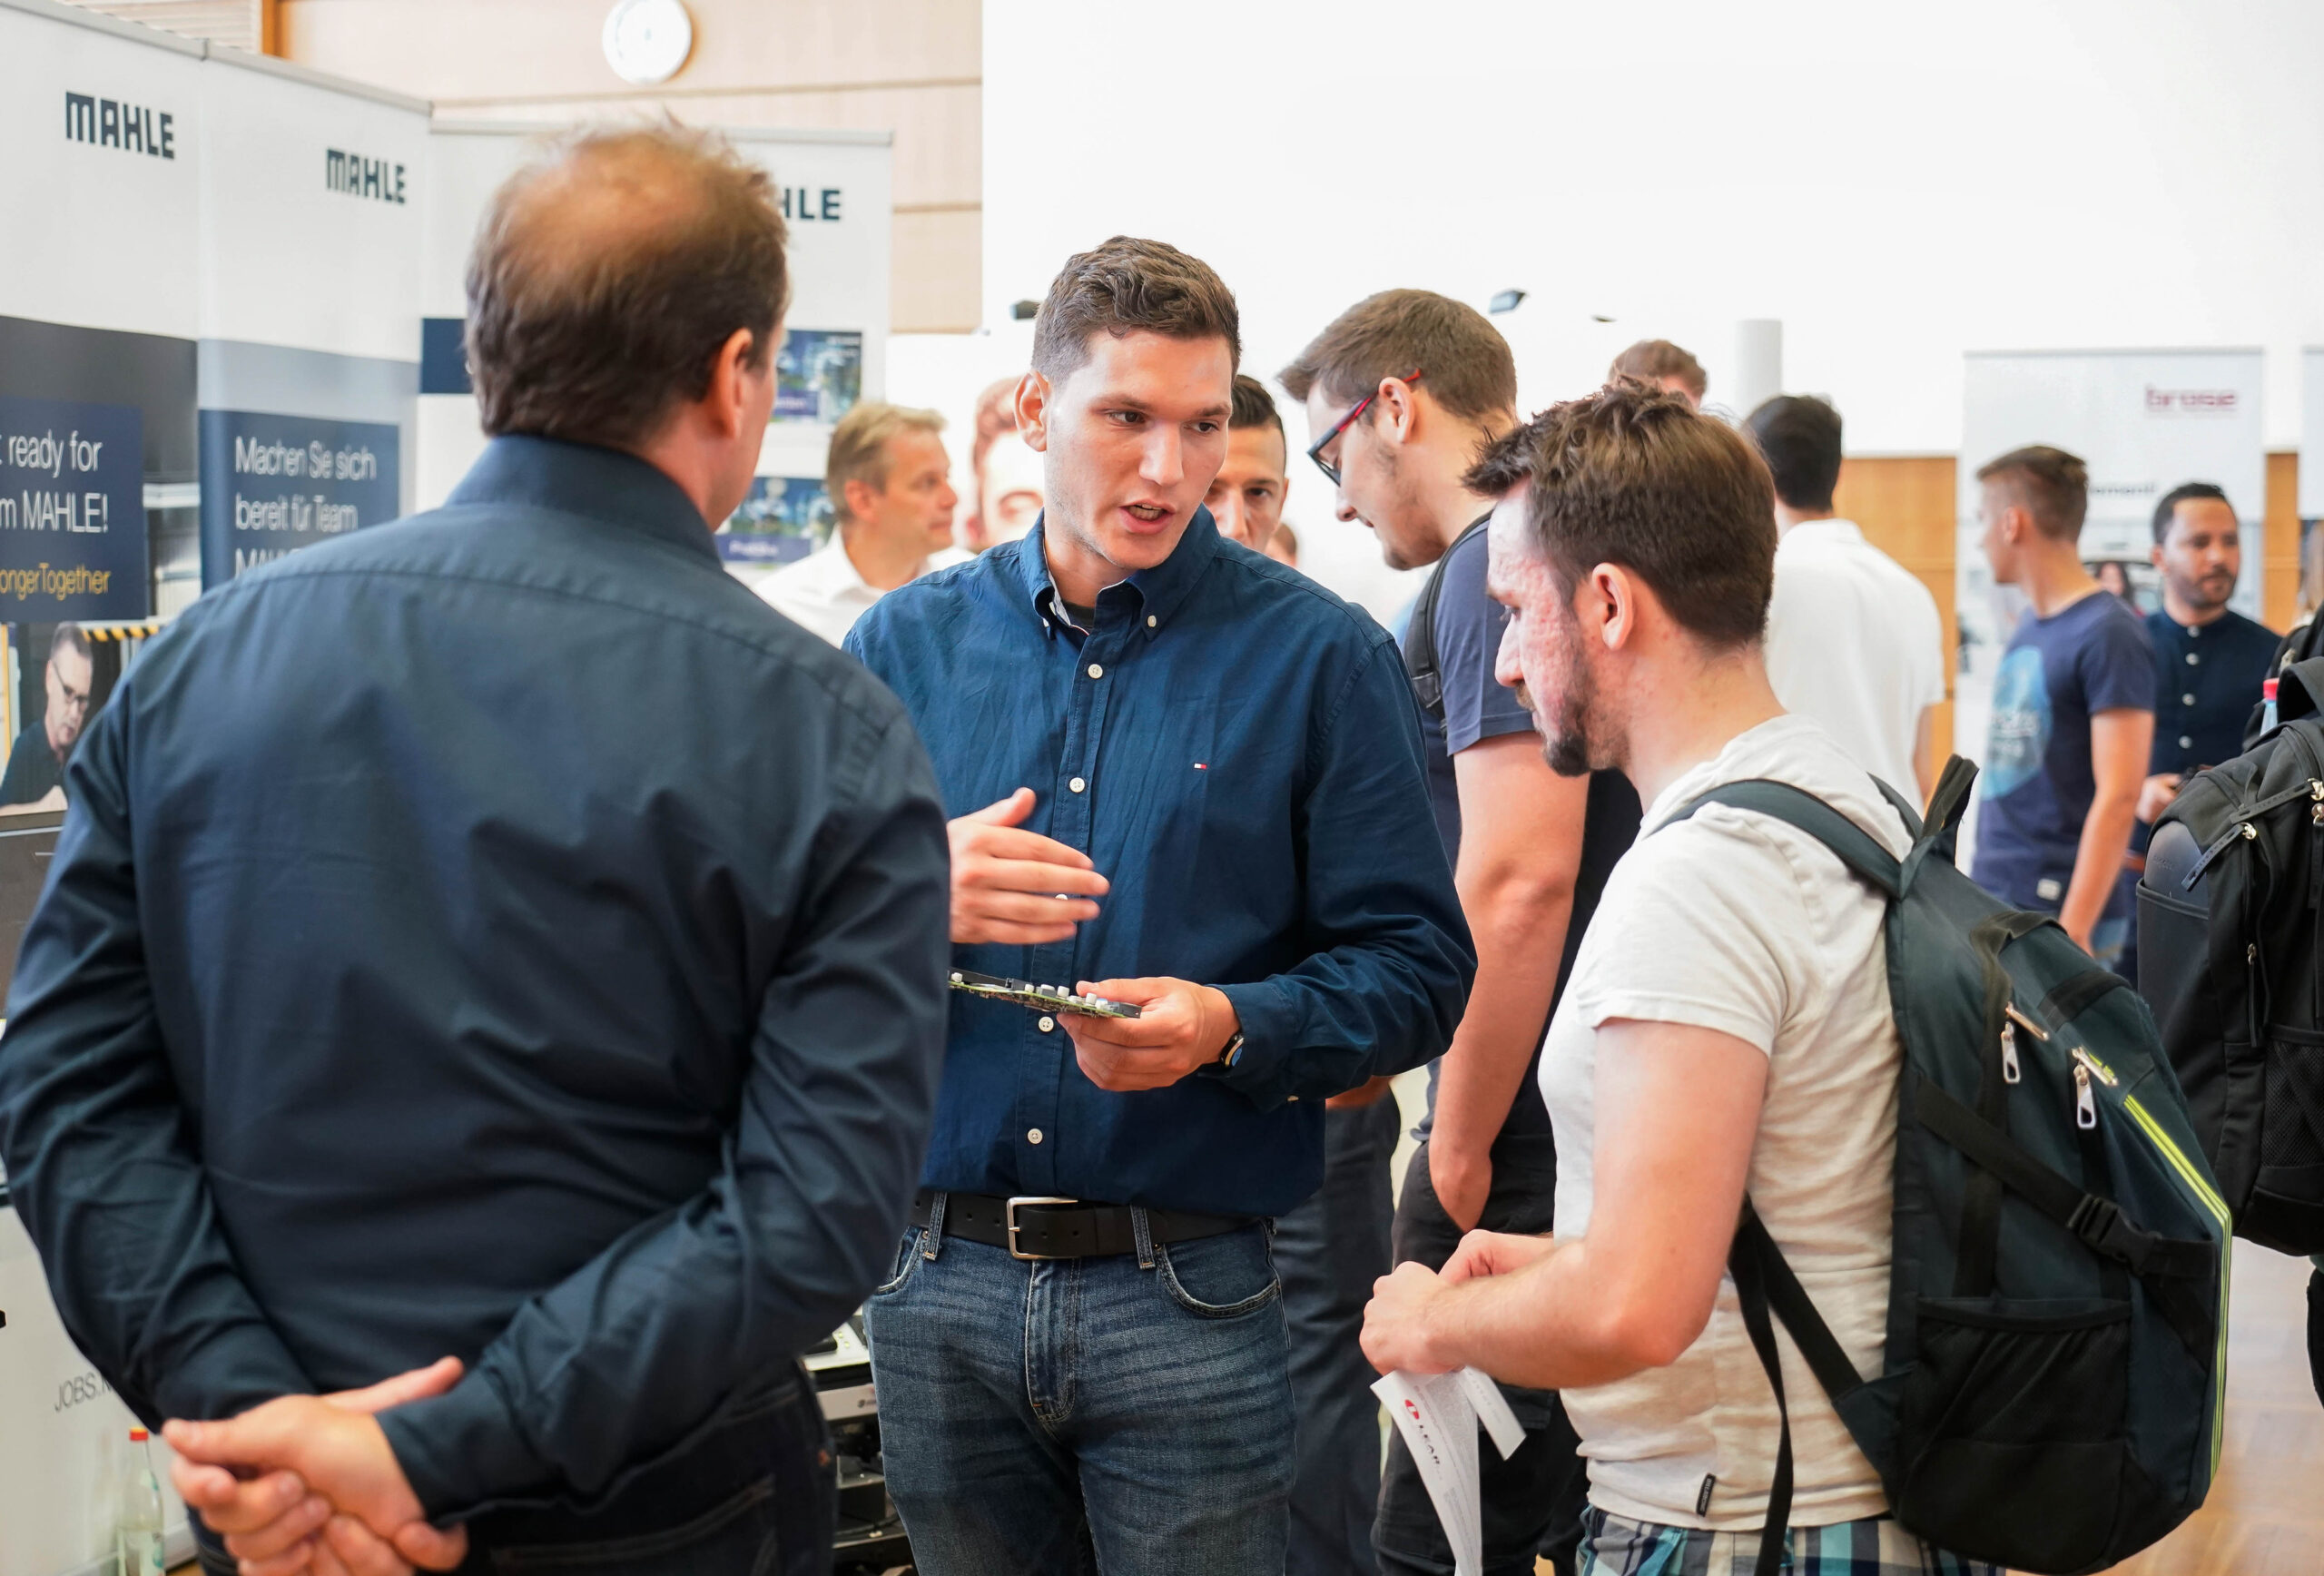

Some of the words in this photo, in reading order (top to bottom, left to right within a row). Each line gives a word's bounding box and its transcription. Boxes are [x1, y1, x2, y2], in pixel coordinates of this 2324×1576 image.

[65, 91, 174, 159] MAHLE
[327, 148, 406, 203] MAHLE
[9, 428, 64, 478] ready
[70, 430, 103, 472] for
[235, 436, 307, 478] Machen
[309, 440, 333, 479] Sie
[335, 443, 377, 480] sich
[23, 489, 109, 534] MAHLE!
[235, 492, 289, 530] bereit
[291, 494, 312, 532] für
[313, 494, 359, 533] Team
[0, 562, 112, 601] ongerTogether
